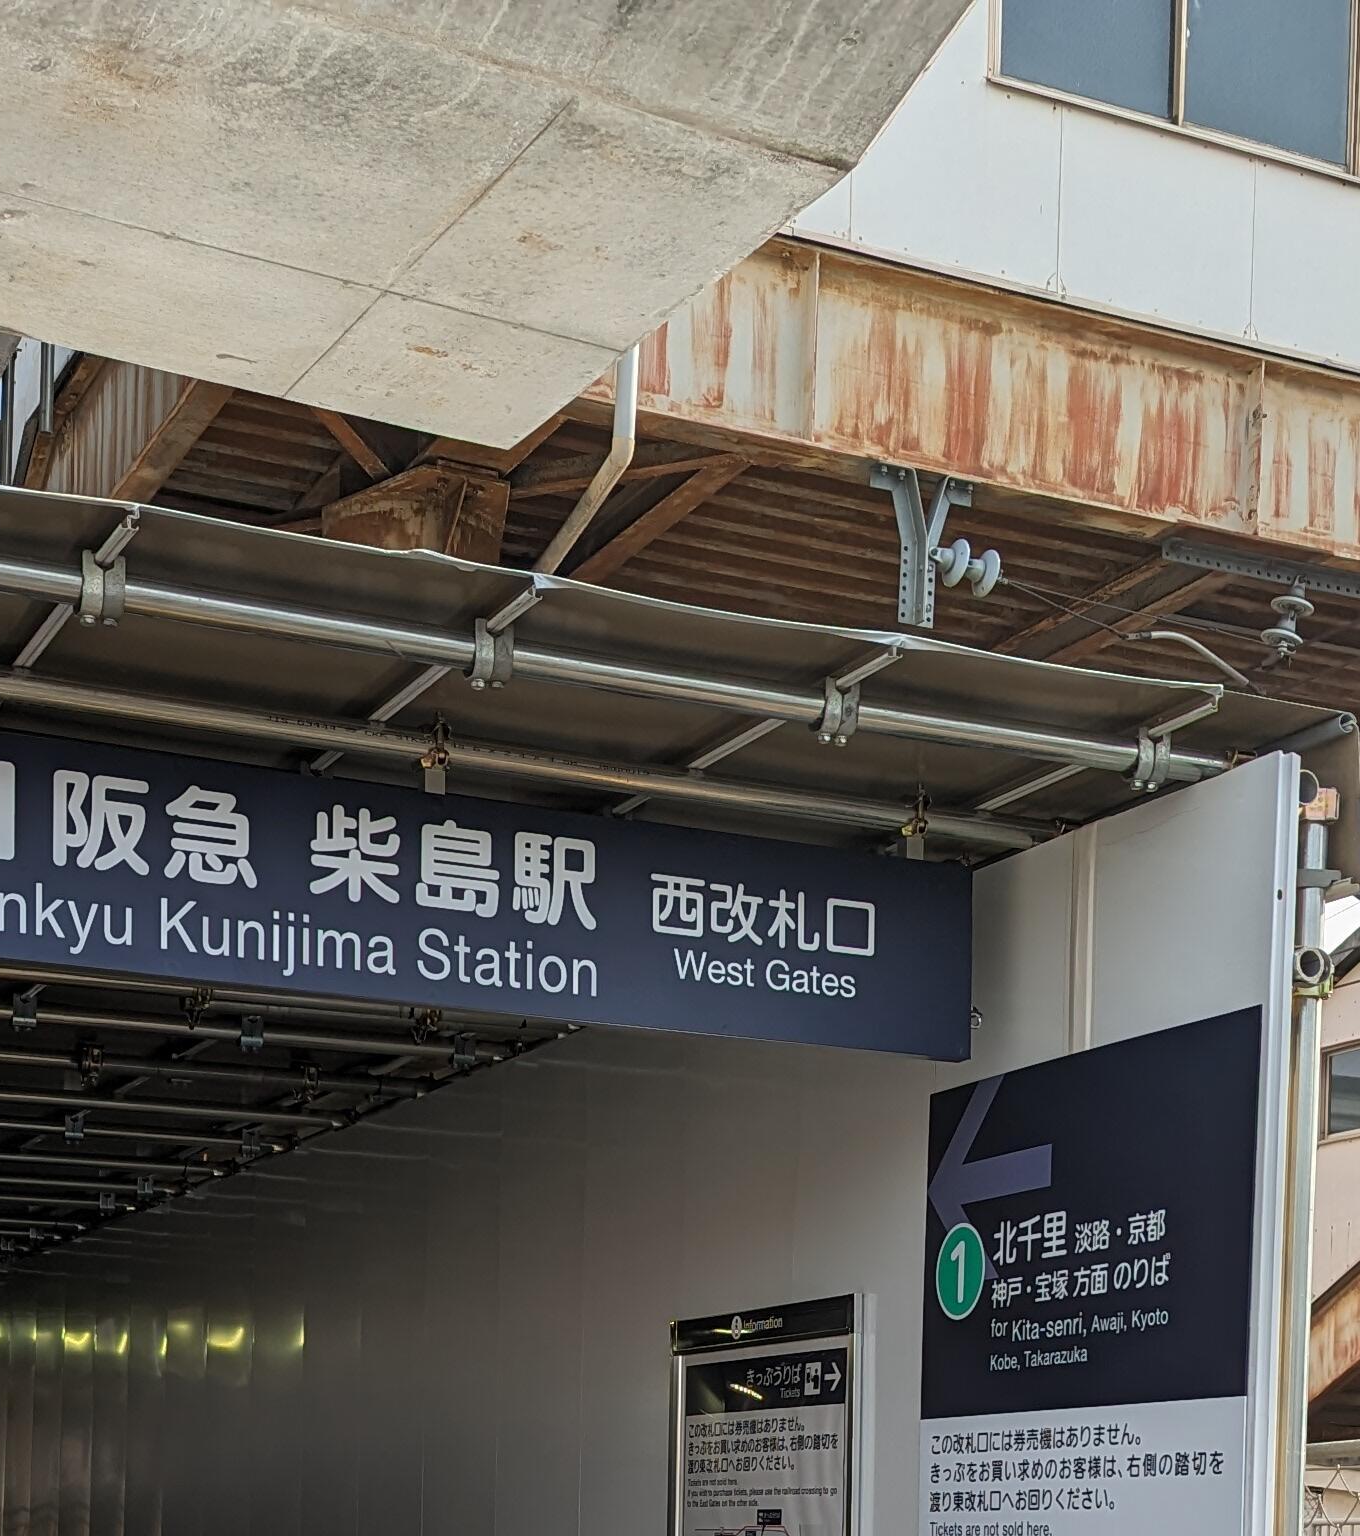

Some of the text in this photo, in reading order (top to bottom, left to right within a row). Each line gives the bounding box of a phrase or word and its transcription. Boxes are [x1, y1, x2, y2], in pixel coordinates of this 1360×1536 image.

[52, 768, 597, 931] 阪急 柴島駅
[650, 872, 876, 957] 西改札口
[160, 897, 397, 977] Kunijima
[416, 927, 598, 997] Station
[673, 947, 857, 998] West Gates
[992, 1208, 1167, 1267] 北千里 淡路・京都
[950, 1240, 966, 1304] 1
[990, 1252, 1171, 1309] 神戸・宝塚 方面 のりば
[743, 1315, 784, 1332] Information
[990, 1307, 1169, 1343] for Kita-senri, Awaji, Kyoto
[746, 1361, 802, 1388] きっぷうりば
[989, 1346, 1088, 1372] Kobe, Takarazuka
[779, 1387, 801, 1399] Tickets
[931, 1422, 1141, 1455] この改札口には券売機はありません。
[929, 1450, 1225, 1484] きっぷをお買い求めのお客様は、右側の踏切を
[928, 1487, 1116, 1513] 渡り東改札口へお回りください。
[929, 1521, 1053, 1536] Tickets are not sold here.
